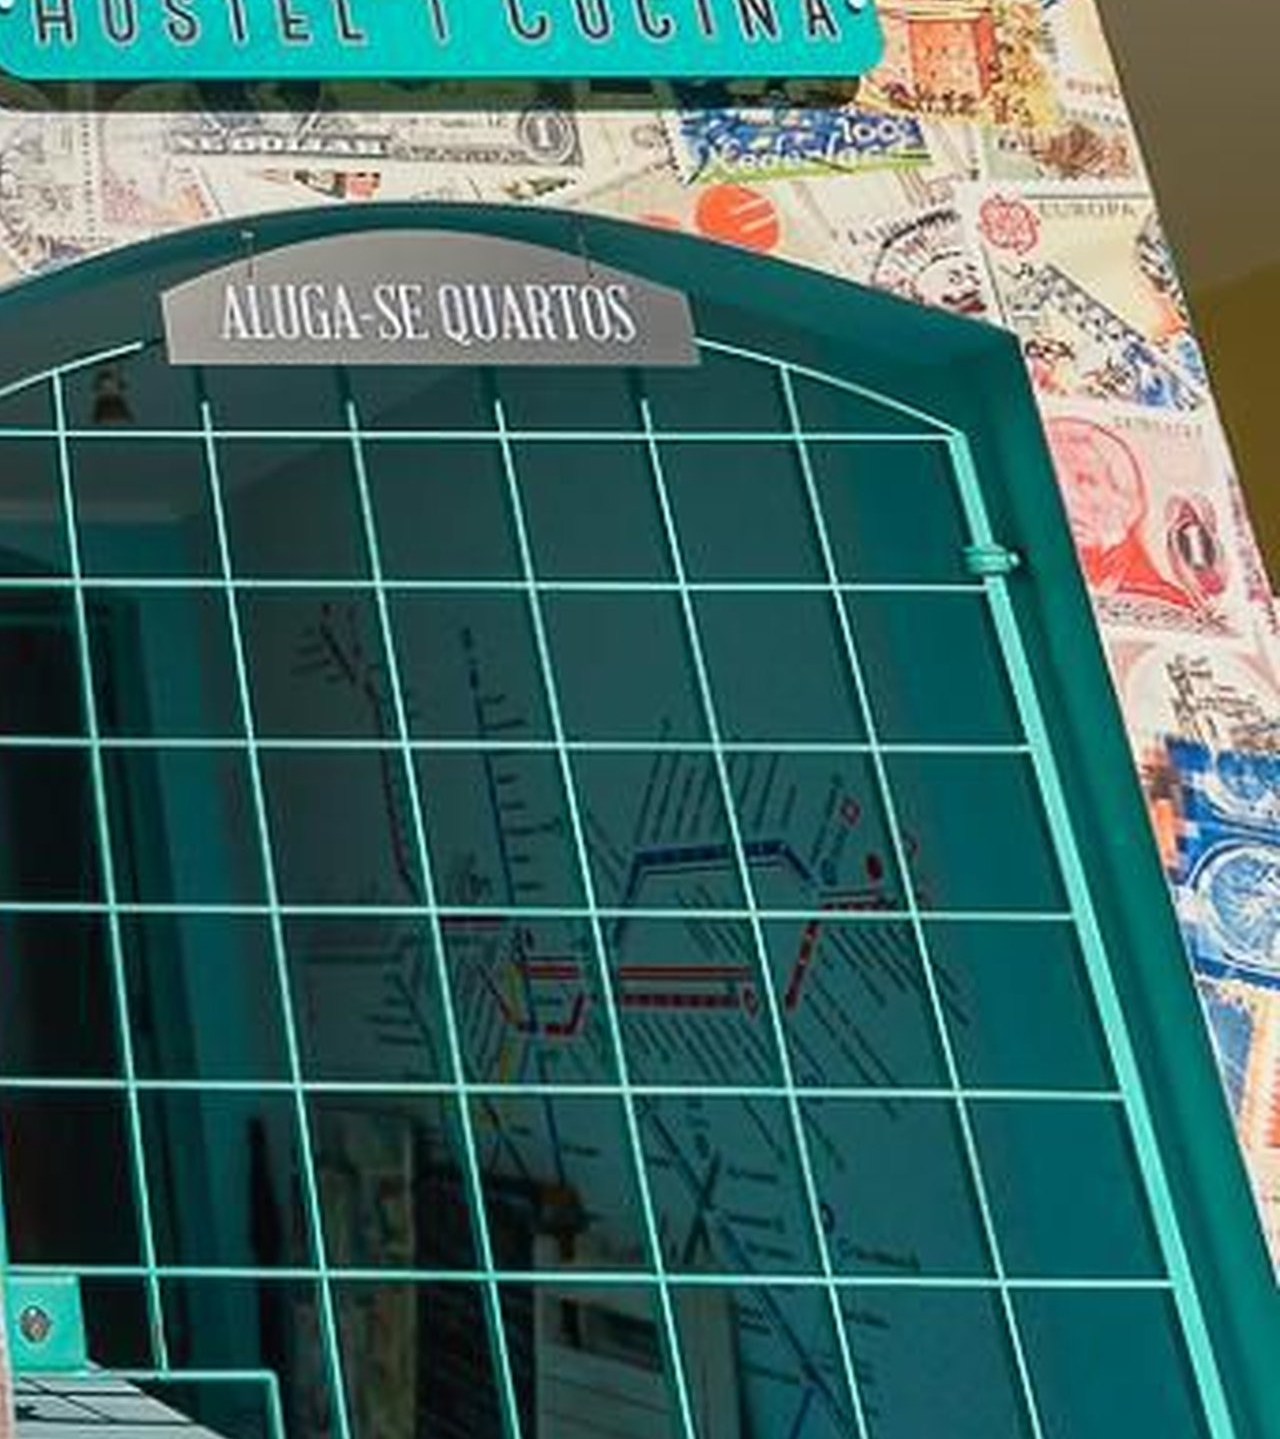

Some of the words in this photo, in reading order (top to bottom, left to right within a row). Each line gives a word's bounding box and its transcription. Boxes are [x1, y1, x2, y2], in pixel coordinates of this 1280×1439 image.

[1039, 201, 1137, 217] EUROPA
[220, 282, 428, 342] ALUGA-SE
[434, 282, 638, 343] QUARTOS
